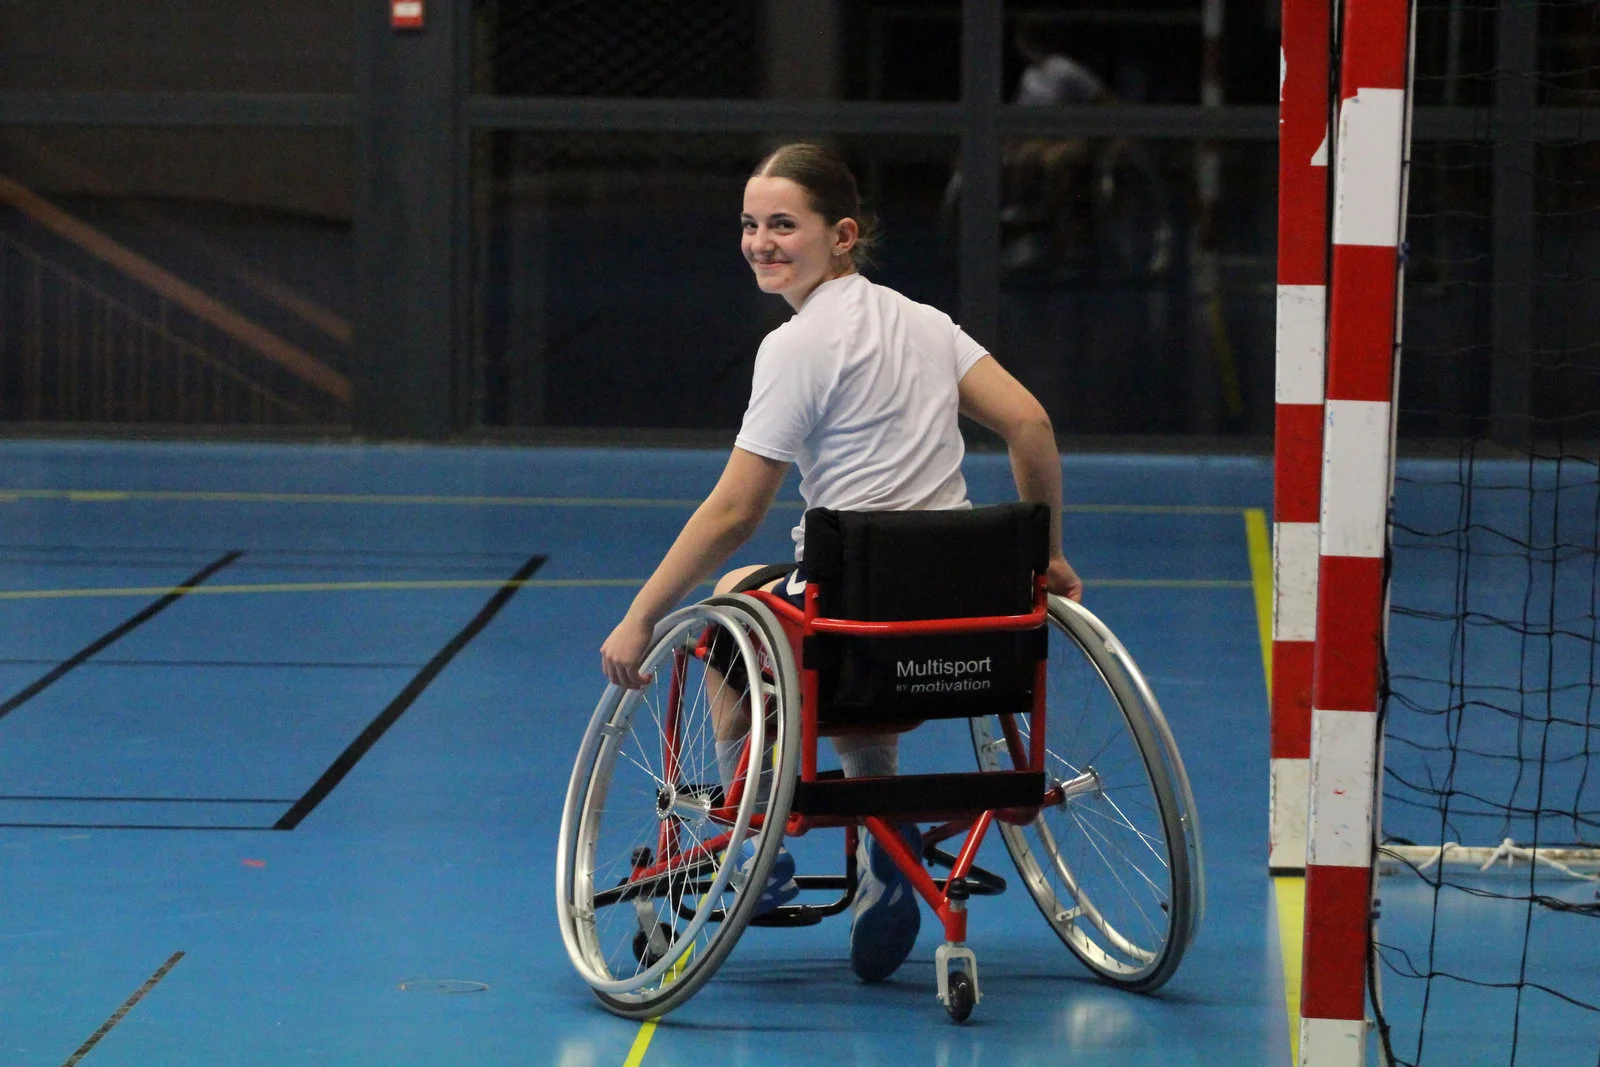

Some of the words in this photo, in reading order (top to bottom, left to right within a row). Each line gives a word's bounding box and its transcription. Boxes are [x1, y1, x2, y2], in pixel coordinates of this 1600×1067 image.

[896, 656, 992, 677] Multisport
[896, 684, 907, 692] BY
[910, 678, 991, 694] motivation
